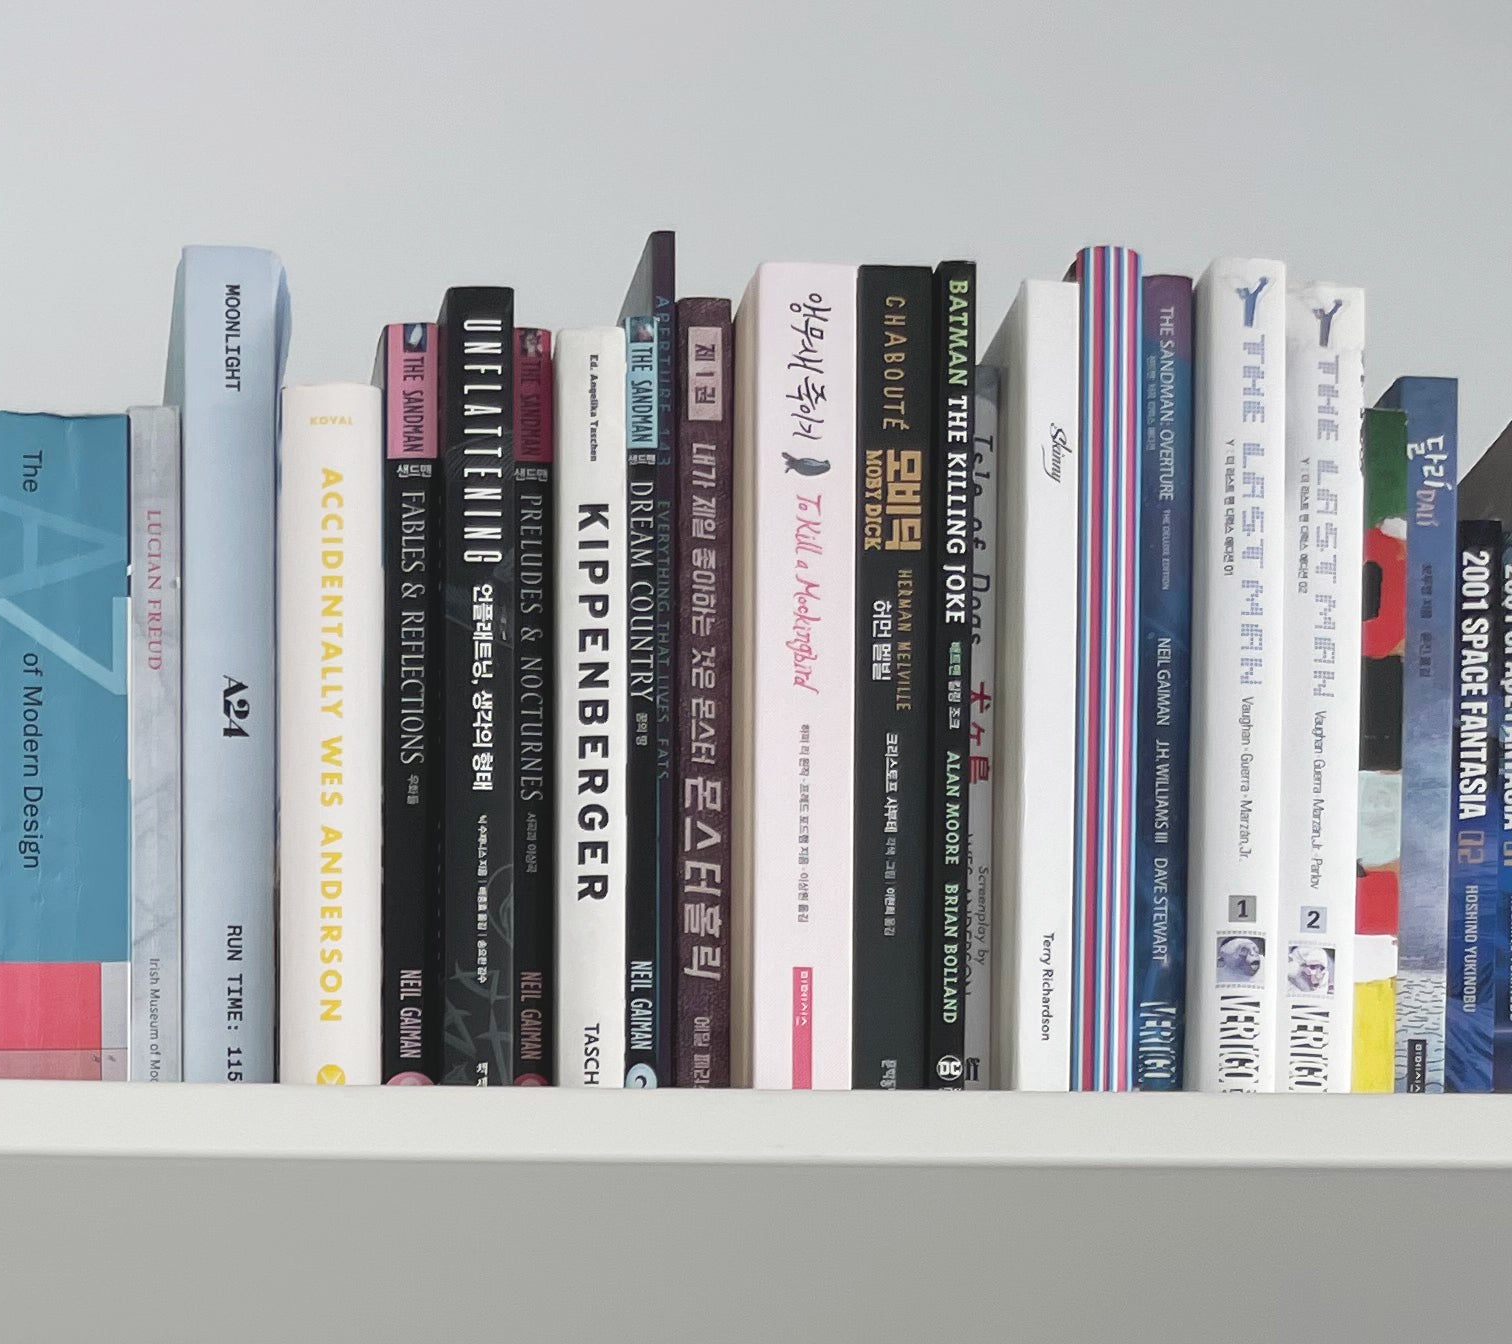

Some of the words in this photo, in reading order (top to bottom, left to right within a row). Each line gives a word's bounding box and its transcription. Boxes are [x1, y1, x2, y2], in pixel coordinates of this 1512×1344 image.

[223, 284, 241, 393] MOONLIGHT
[787, 292, 832, 375] 앵무새
[946, 279, 969, 386] BATMAN
[1158, 306, 1175, 337] THE
[784, 376, 827, 441] 죽이기
[1157, 339, 1175, 427] SANDMAN:
[461, 319, 503, 563] UNFLATTENING
[946, 395, 968, 443] THE
[395, 464, 432, 478] 샌드맨
[690, 442, 717, 488] 내가
[1157, 429, 1175, 501] OVERTURE
[1405, 435, 1452, 491] 달리
[628, 481, 655, 567] DREAM
[690, 495, 717, 538] 제일
[883, 448, 923, 551] 모비딕
[945, 452, 968, 555] KILLING
[145, 509, 162, 591] LUCIAN
[1460, 549, 1490, 613] 2001
[318, 468, 345, 720] ACCIDENTALLY
[690, 547, 717, 637] 좋아하는
[870, 600, 892, 638] 허먼
[942, 564, 967, 625] JOKE
[146, 599, 163, 671] FREUD
[469, 583, 494, 685] 언플래트닝,
[628, 581, 655, 702] COUNTRY
[689, 648, 716, 689] 것은
[870, 643, 892, 681] 멜빌
[1154, 637, 1171, 668] NEIL
[1459, 617, 1490, 696] SPACE
[221, 674, 251, 738] A24
[470, 690, 494, 748] 생각의
[576, 503, 610, 902] KIPPENBERGER
[688, 696, 716, 765] 몬스터
[1154, 669, 1171, 726] GAIMAN
[318, 736, 345, 807] WES
[470, 751, 494, 791] 형태
[944, 751, 961, 797] ALAN
[1457, 701, 1489, 821] FANTASIA
[943, 803, 961, 865] MOORE
[682, 775, 722, 981] 몬스터홀릭
[1152, 857, 1169, 893] DAVE
[319, 825, 346, 1022] ANDERSON
[942, 883, 959, 937] BRIAN
[1150, 895, 1168, 964] STEWART
[1463, 884, 1479, 943] HOSHINO
[1038, 932, 1055, 965] Terry
[1461, 946, 1478, 1014] YUKINOBU
[941, 944, 959, 1024] BOLLAND
[1039, 968, 1055, 1042] Richardson
